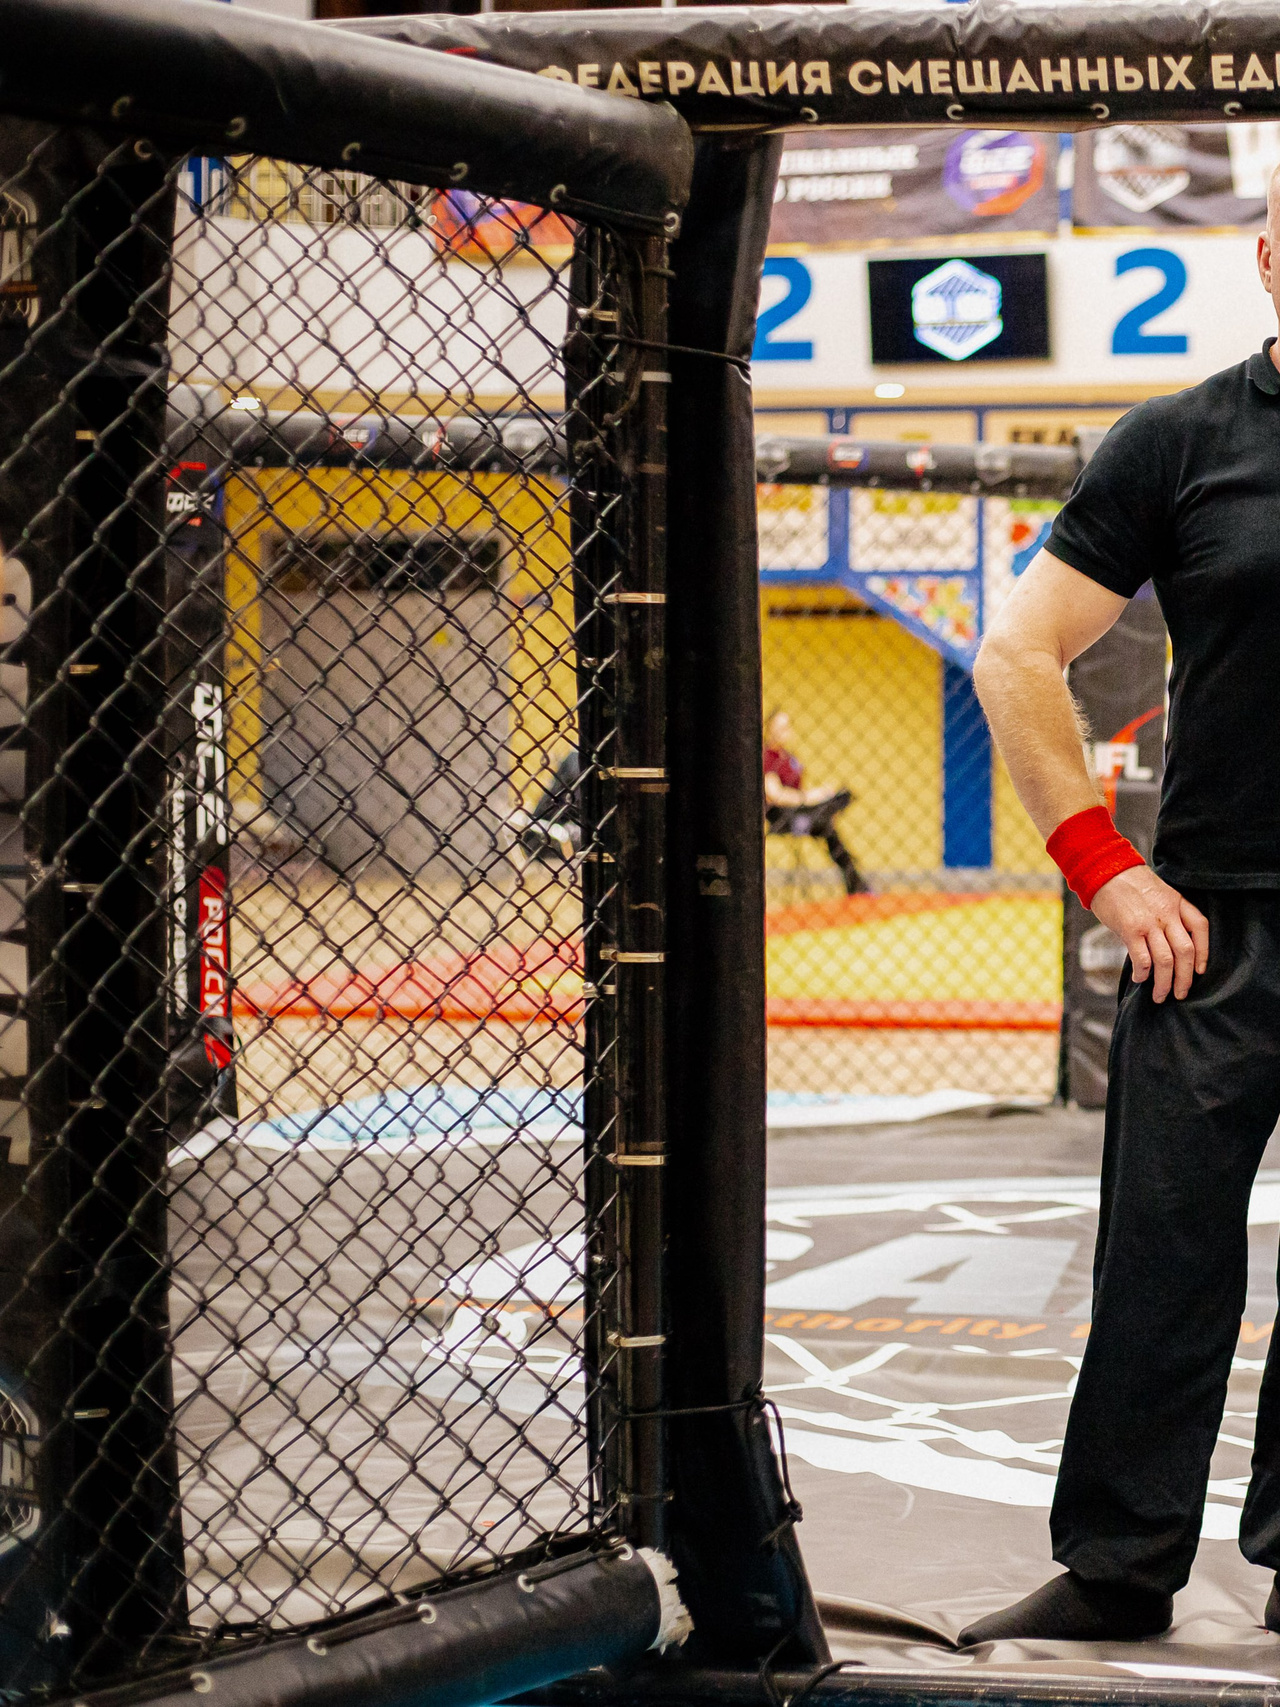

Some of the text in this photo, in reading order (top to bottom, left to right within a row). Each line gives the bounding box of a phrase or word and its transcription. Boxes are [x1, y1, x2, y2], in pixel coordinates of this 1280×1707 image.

[848, 55, 1196, 95] СМЕШАННЫХ
[751, 257, 813, 360] 2
[1112, 248, 1187, 354] 2
[202, 896, 227, 1018] РОССИ
